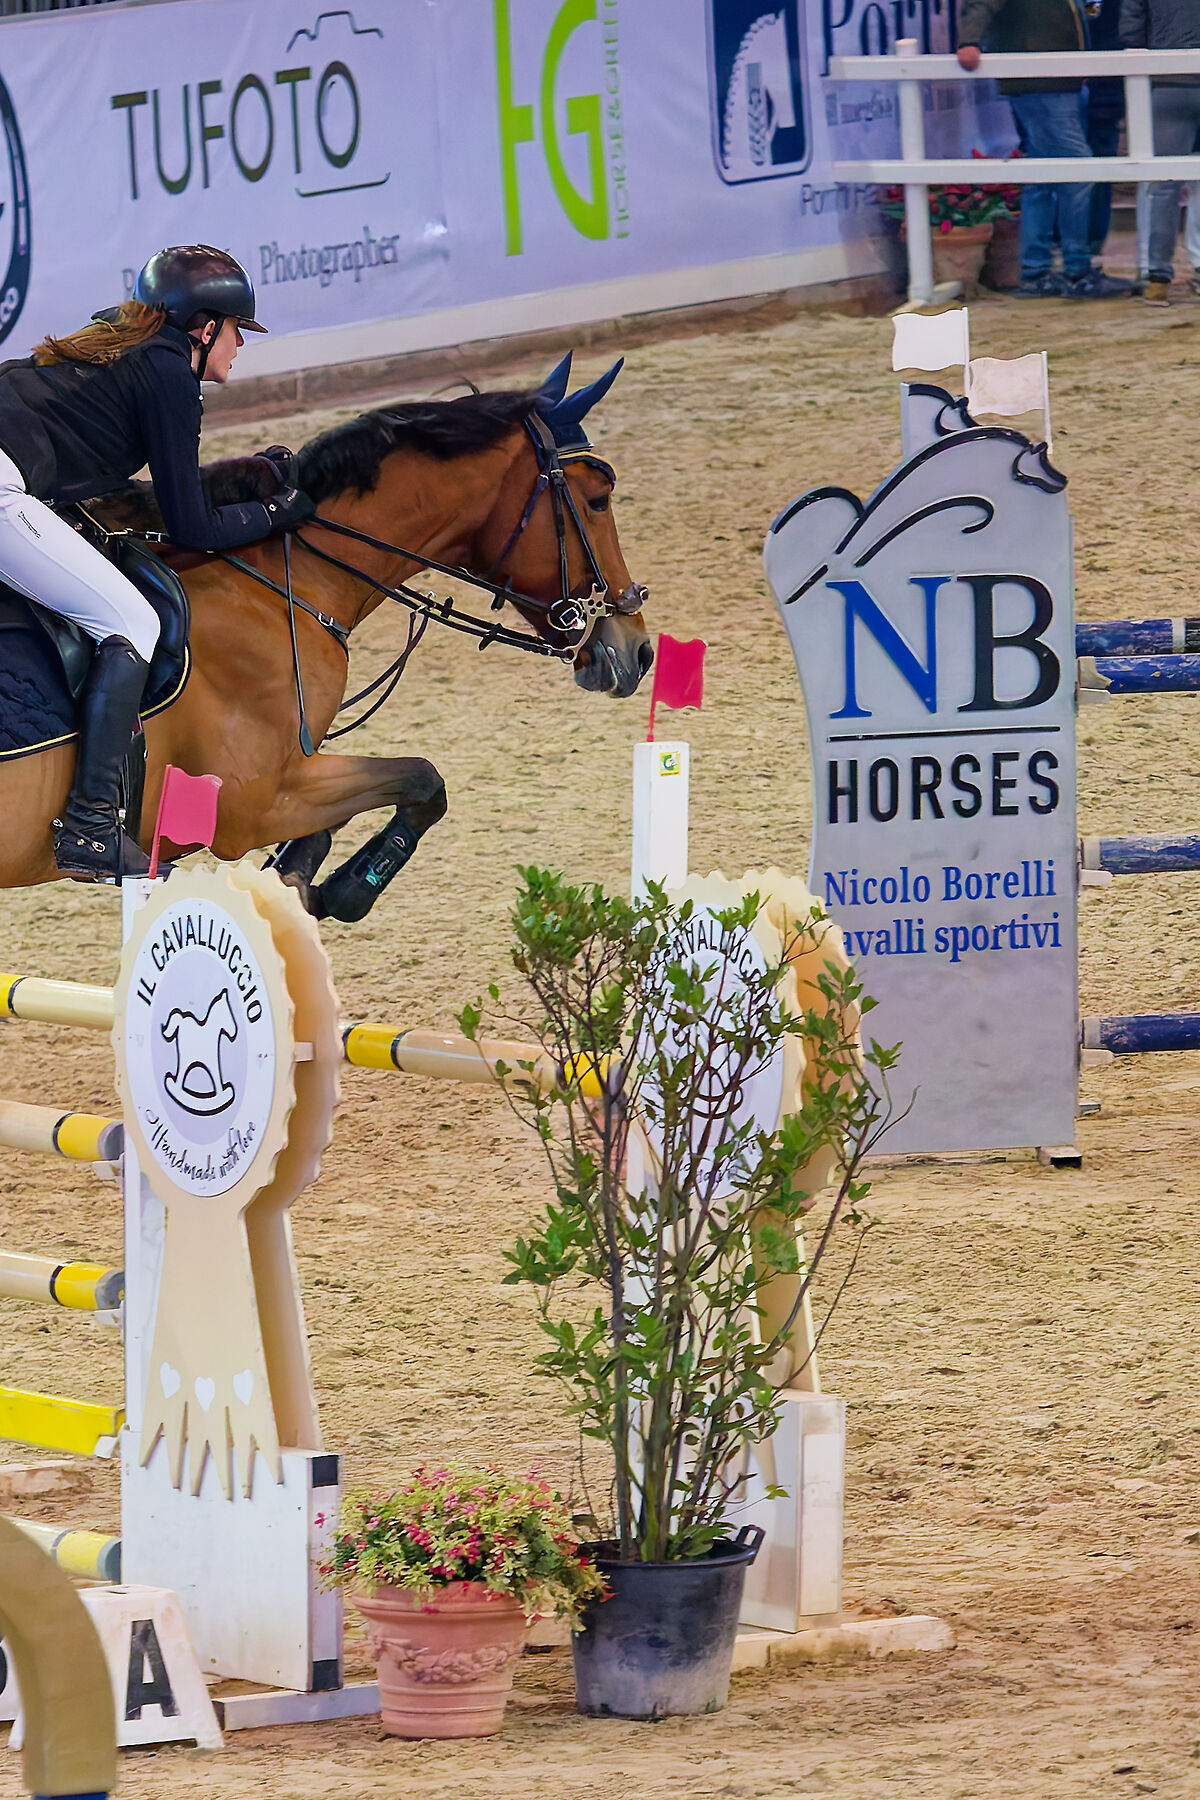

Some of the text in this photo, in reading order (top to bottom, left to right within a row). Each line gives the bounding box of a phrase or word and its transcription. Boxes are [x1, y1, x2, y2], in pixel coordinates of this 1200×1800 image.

[111, 60, 361, 200] TUFOTO
[259, 225, 400, 288] Photographer
[825, 573, 1061, 719] NB
[827, 750, 1060, 824] HORSES
[823, 859, 1057, 907] Nicolo Borelli
[137, 914, 263, 1023] IL CAVALLUCCIO
[843, 911, 1062, 963] avalli sportivi
[145, 1109, 216, 1181] Handmade
[124, 1619, 180, 1721] A
